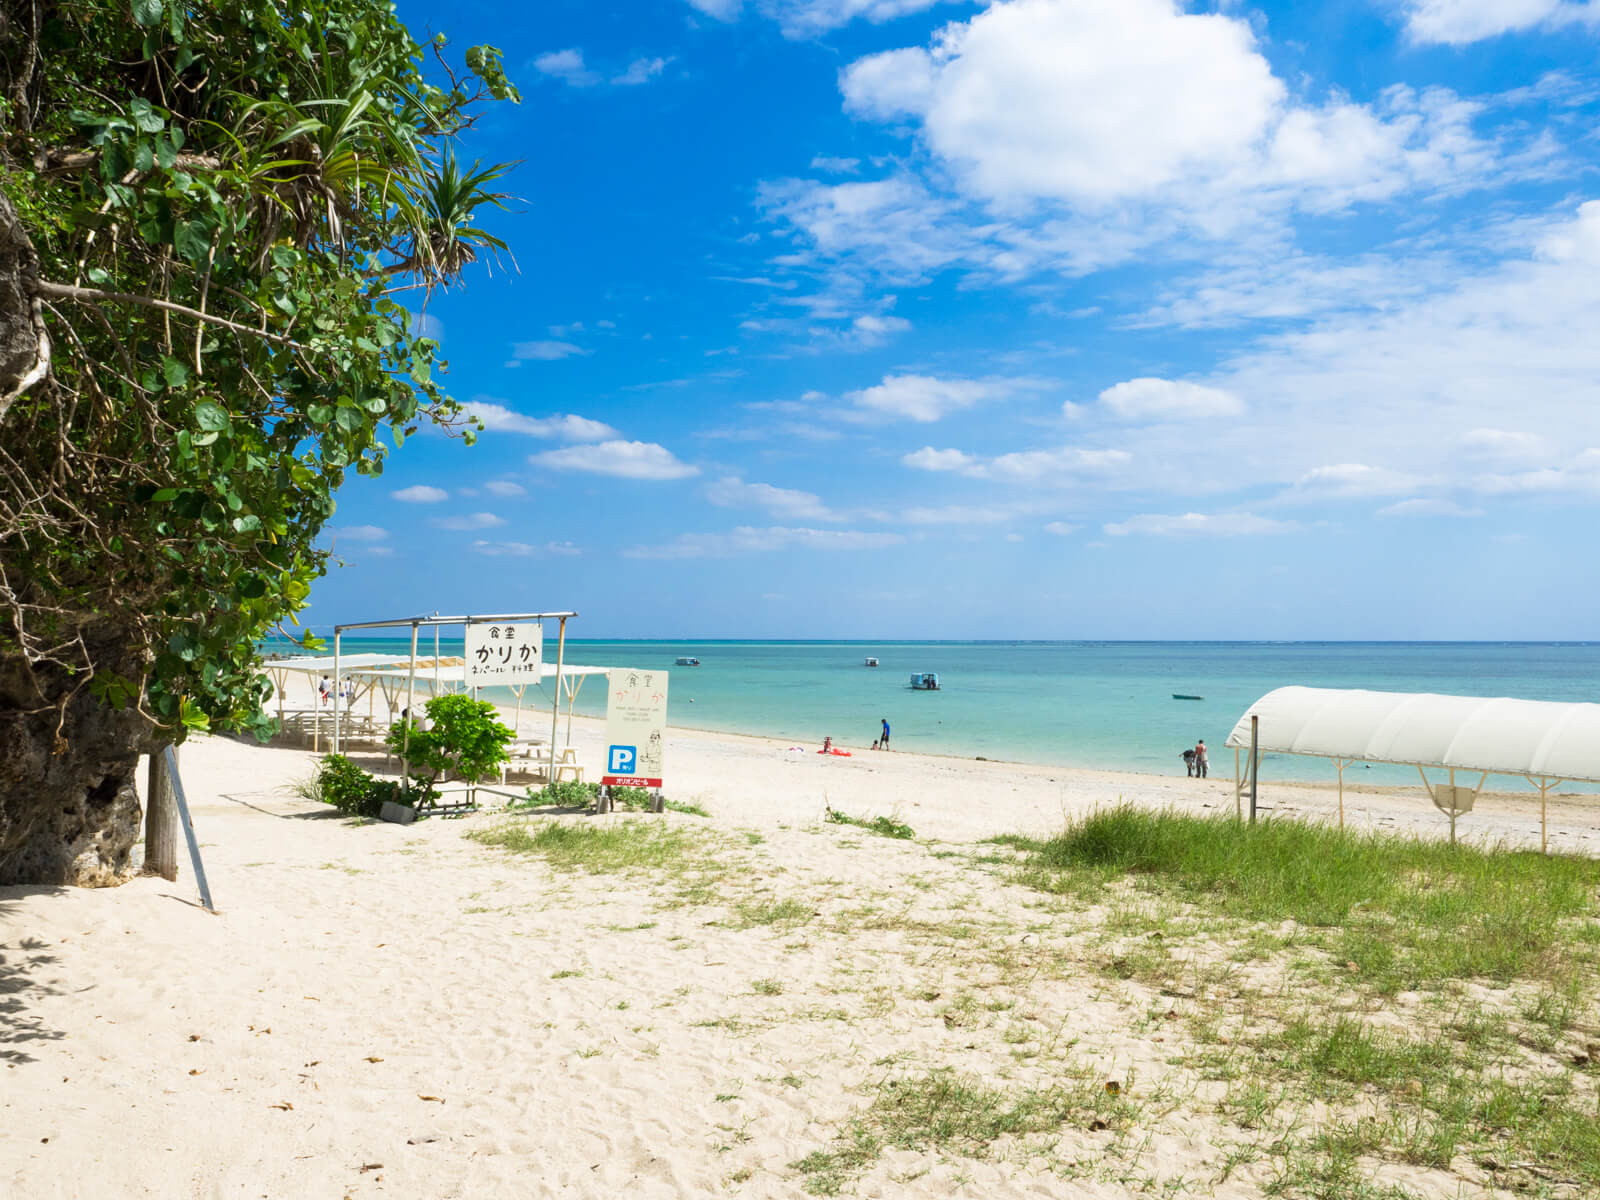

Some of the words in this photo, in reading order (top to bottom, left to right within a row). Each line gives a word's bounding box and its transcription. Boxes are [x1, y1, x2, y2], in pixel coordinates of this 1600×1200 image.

[488, 626, 515, 639] 食堂
[475, 644, 537, 663] かりか
[472, 664, 505, 674] ネパール
[512, 663, 534, 673] 料理
[625, 672, 653, 688] 食堂
[611, 749, 633, 770] P
